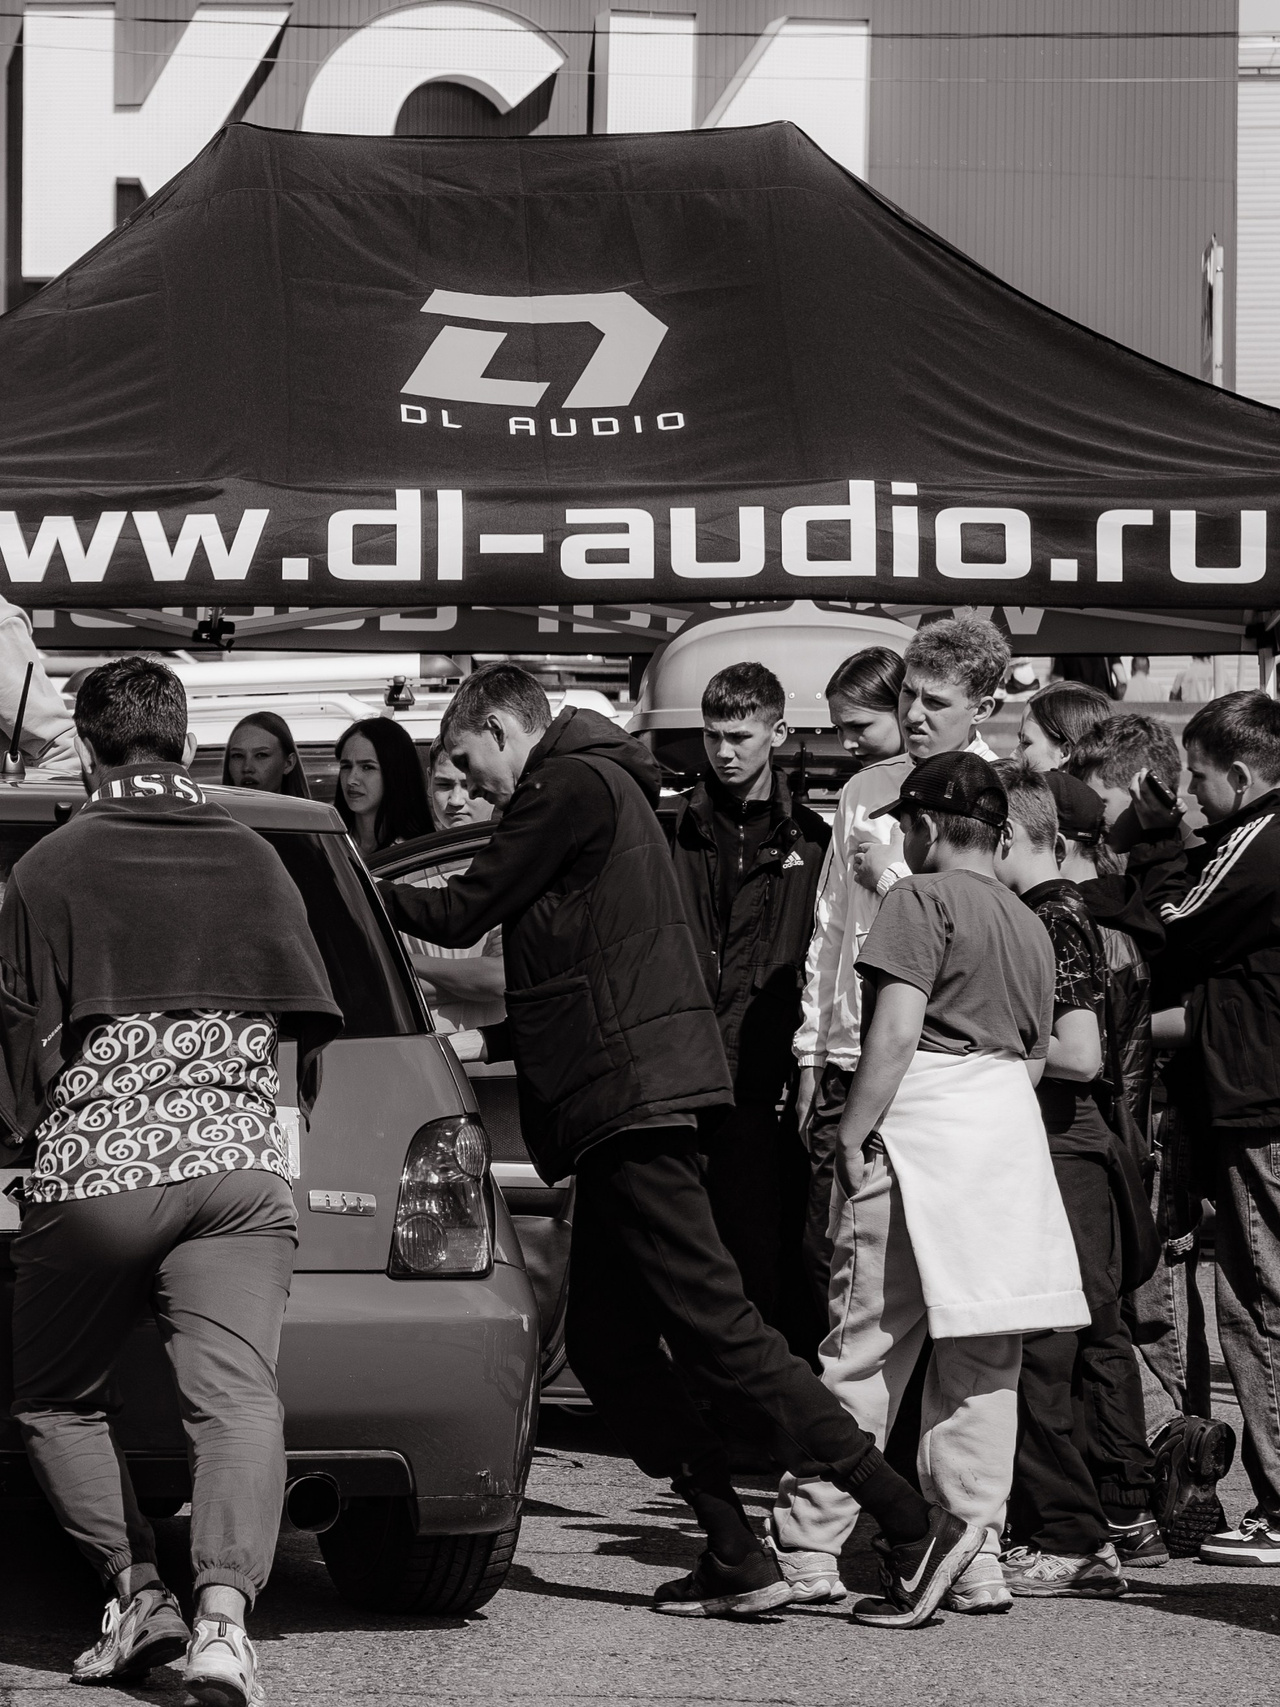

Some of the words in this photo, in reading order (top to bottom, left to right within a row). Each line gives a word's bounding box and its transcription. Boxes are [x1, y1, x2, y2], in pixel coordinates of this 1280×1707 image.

[400, 404, 462, 428] DL
[508, 412, 685, 436] AUDIO
[91, 773, 200, 804] ISS
